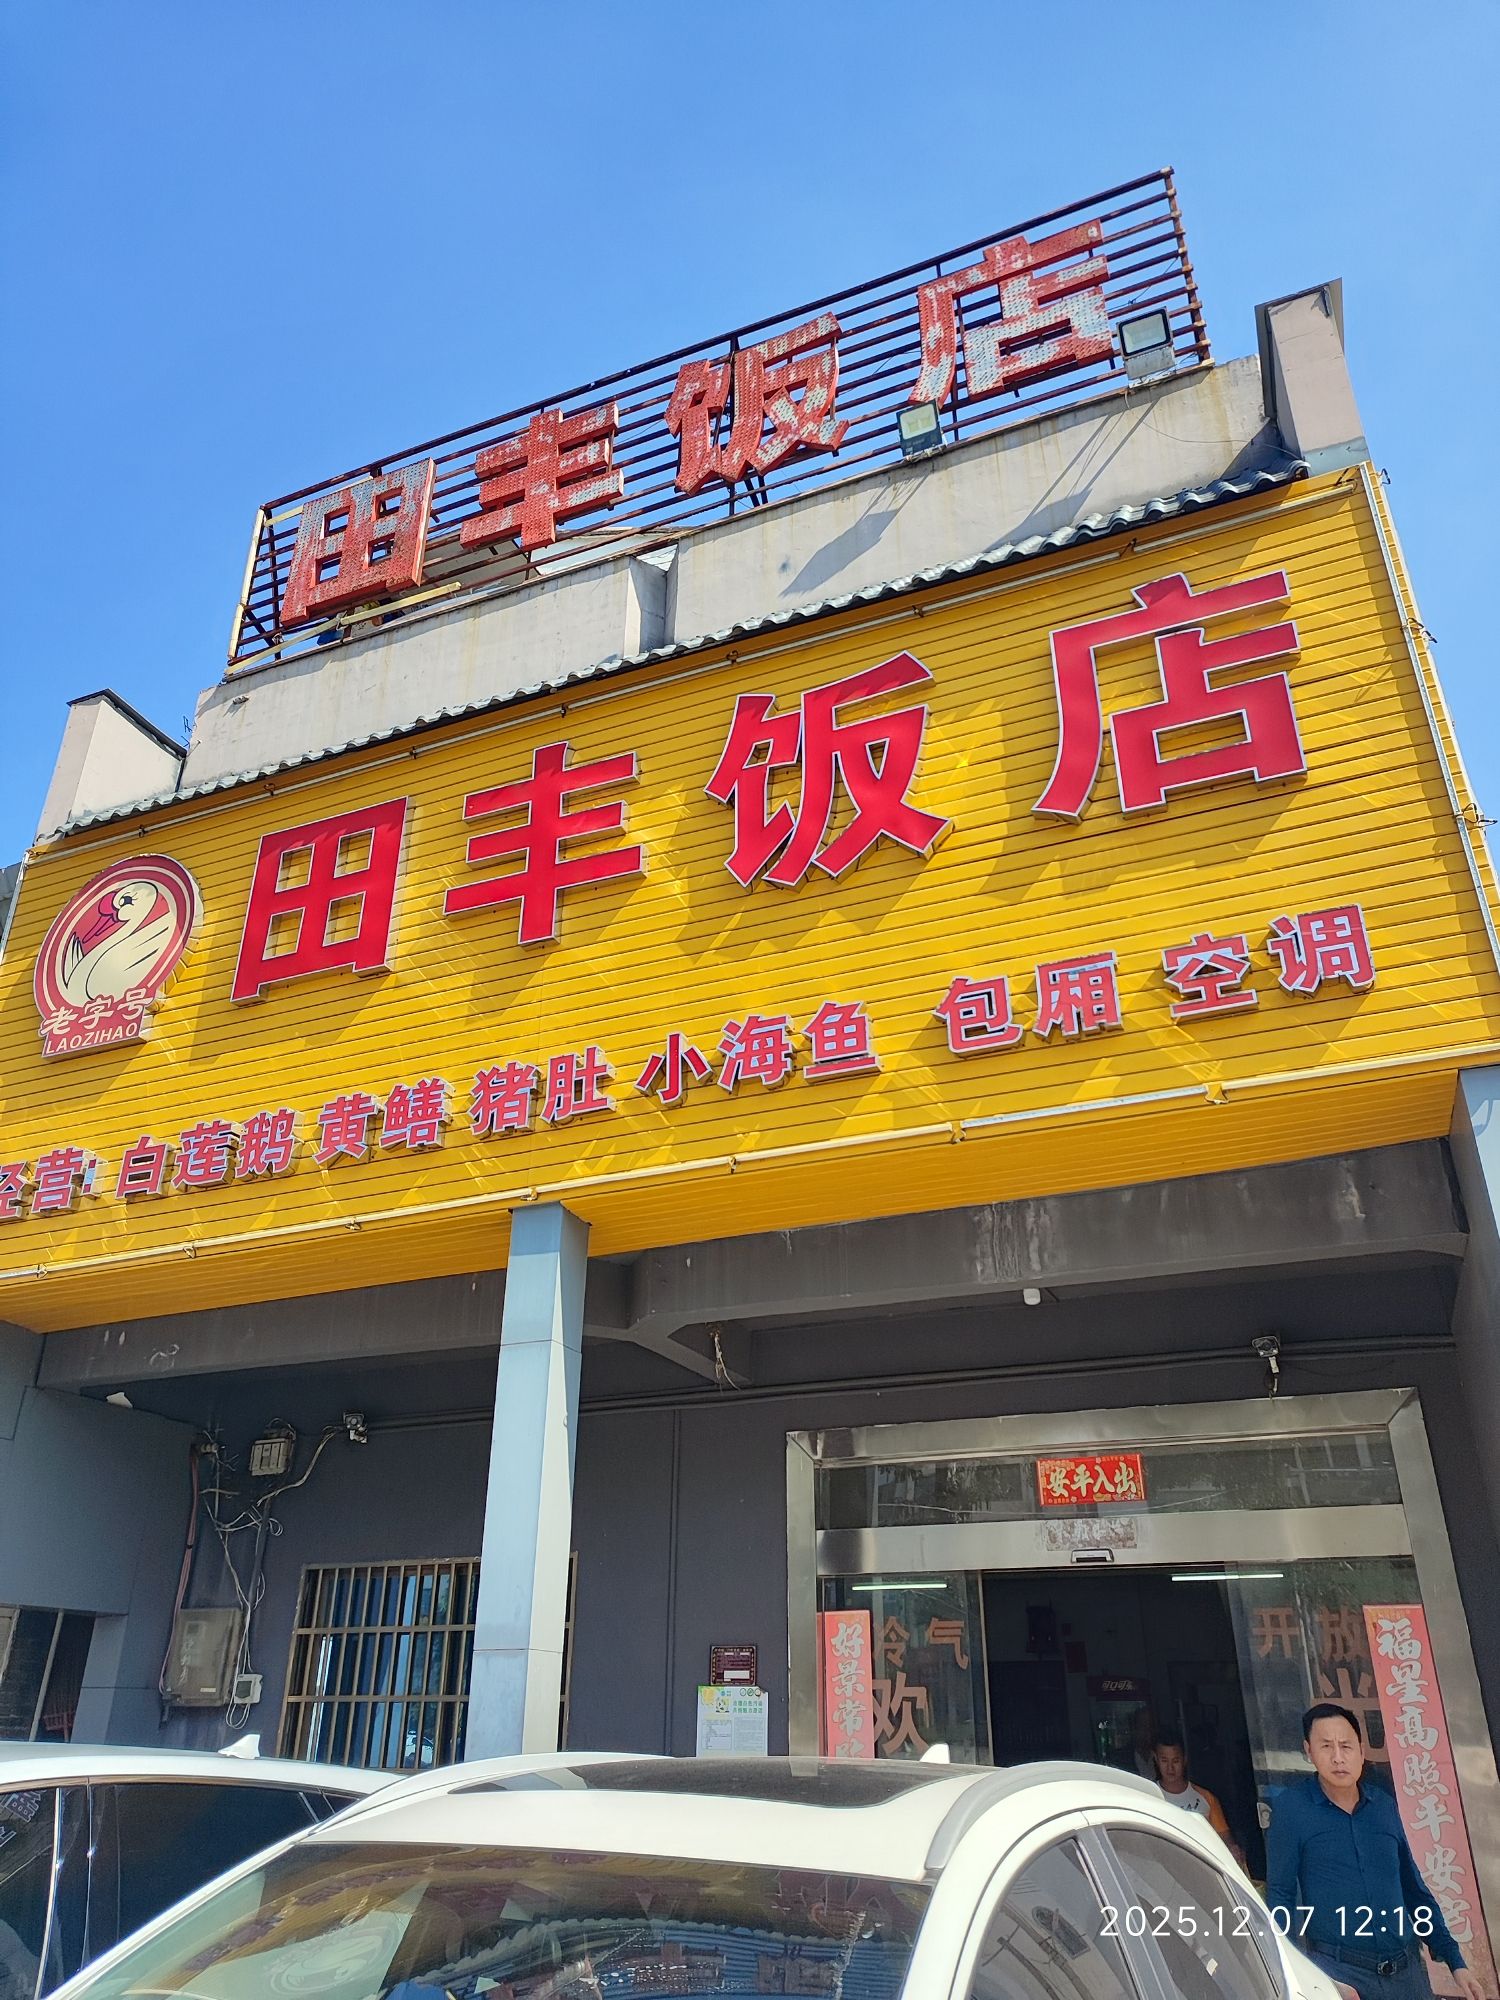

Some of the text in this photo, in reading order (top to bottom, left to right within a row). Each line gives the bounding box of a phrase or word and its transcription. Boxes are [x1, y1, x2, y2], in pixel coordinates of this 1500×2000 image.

[281, 218, 1114, 628] 田丰饭店
[231, 570, 1306, 1003] 田丰饭店
[40, 987, 154, 1036] 老字号
[46, 1022, 138, 1055] LAOZIHAO
[116, 1107, 299, 1200] 白莲鹅
[313, 1077, 449, 1165] 黄鳝
[469, 1046, 614, 1137] 猪肚
[634, 1000, 881, 1104] 小海鱼
[935, 950, 1122, 1055] 包厢
[1162, 903, 1376, 1018] 空调
[873, 1616, 969, 1670] 冷气
